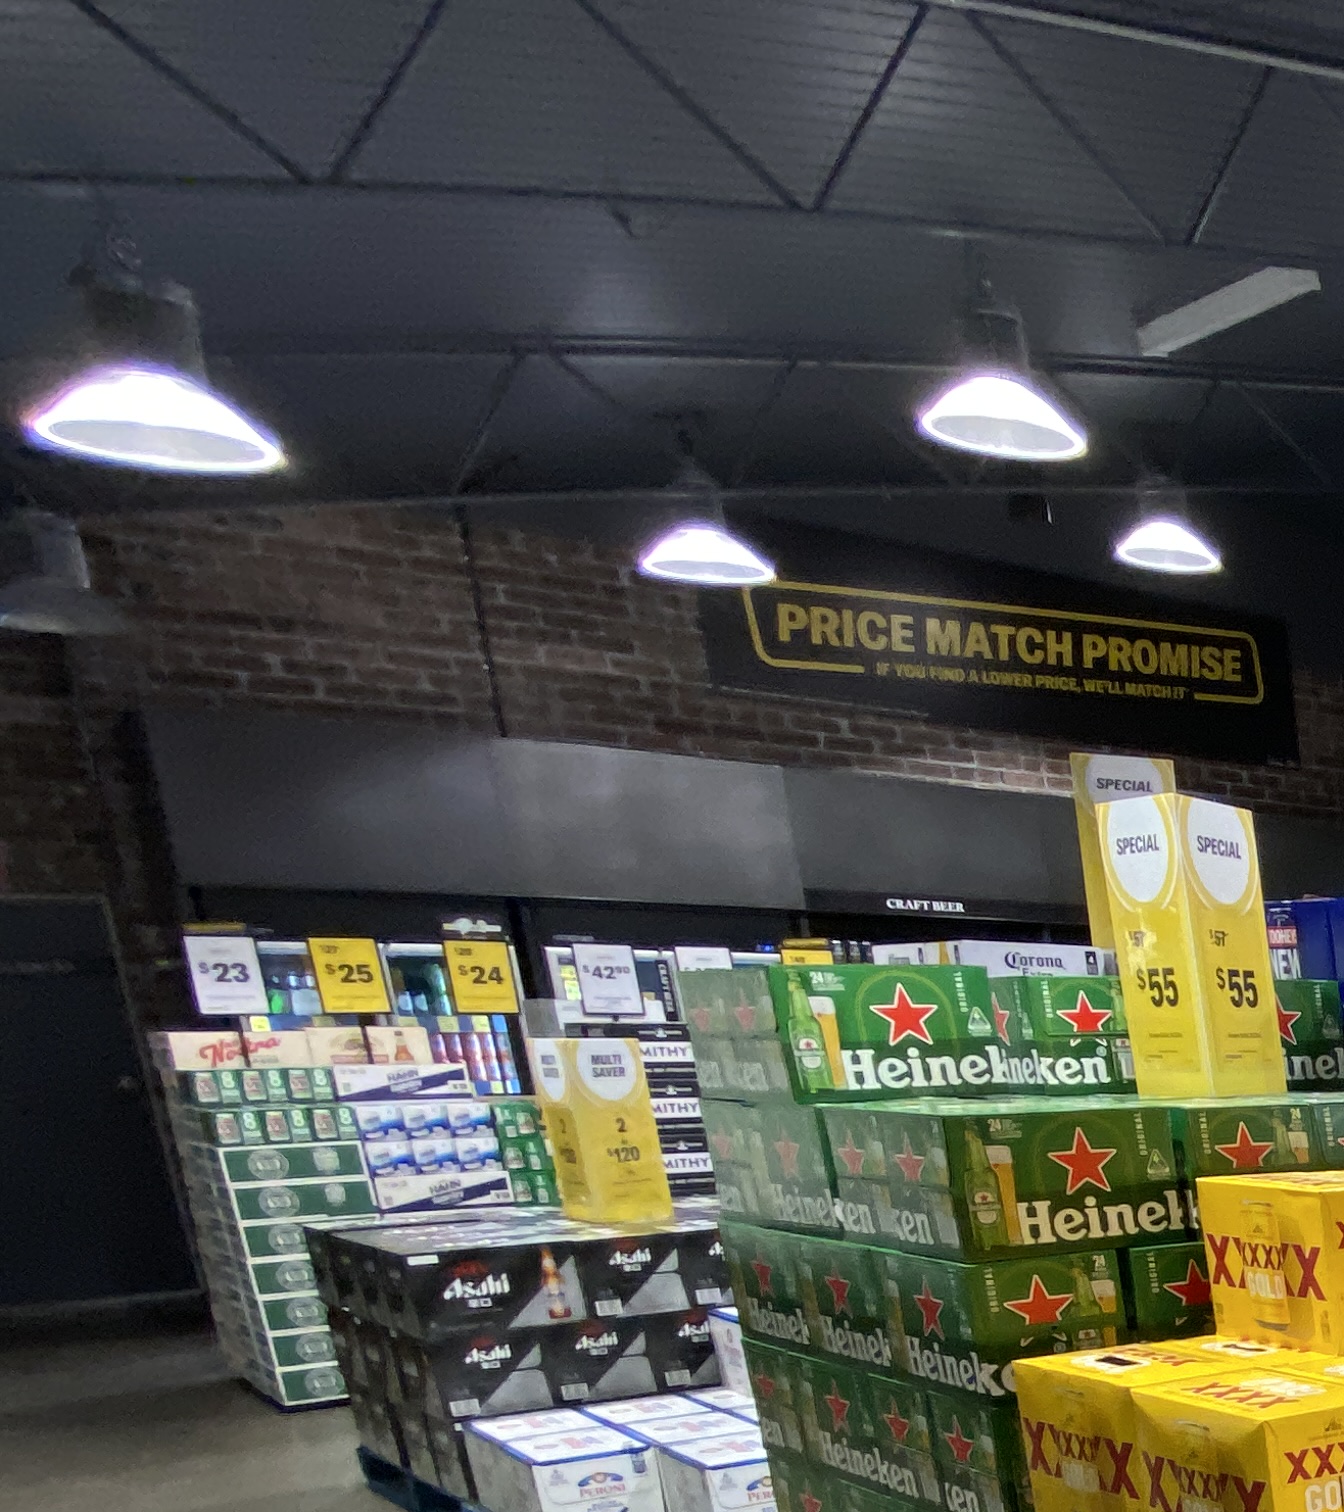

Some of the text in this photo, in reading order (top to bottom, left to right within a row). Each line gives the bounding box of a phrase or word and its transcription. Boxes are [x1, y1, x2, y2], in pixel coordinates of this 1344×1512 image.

[778, 603, 1243, 682] PRICE MATCH PROMISE
[895, 664, 926, 679] YOU
[981, 669, 1033, 687] LOWER
[1035, 674, 1080, 692] PRICE,
[1126, 682, 1170, 699] MATCH
[1096, 777, 1152, 792] SPECIAL
[1116, 834, 1159, 855] SPECIAL
[1197, 835, 1241, 859] SPECIAL
[886, 899, 965, 912] CRAFT BEER
[1005, 951, 1064, 969] Corona
[198, 962, 251, 983] $23
[324, 963, 374, 984] $25
[458, 965, 504, 985] $24
[1136, 968, 1179, 1008] $55
[1216, 968, 1258, 1008] $55
[591, 1054, 622, 1065] MULTI
[592, 1066, 625, 1077] SAVER
[615, 1118, 627, 1132] 2
[609, 1248, 651, 1266] Asahi
[444, 1273, 510, 1300] Asahi
[580, 1484, 626, 1498] PERONI
